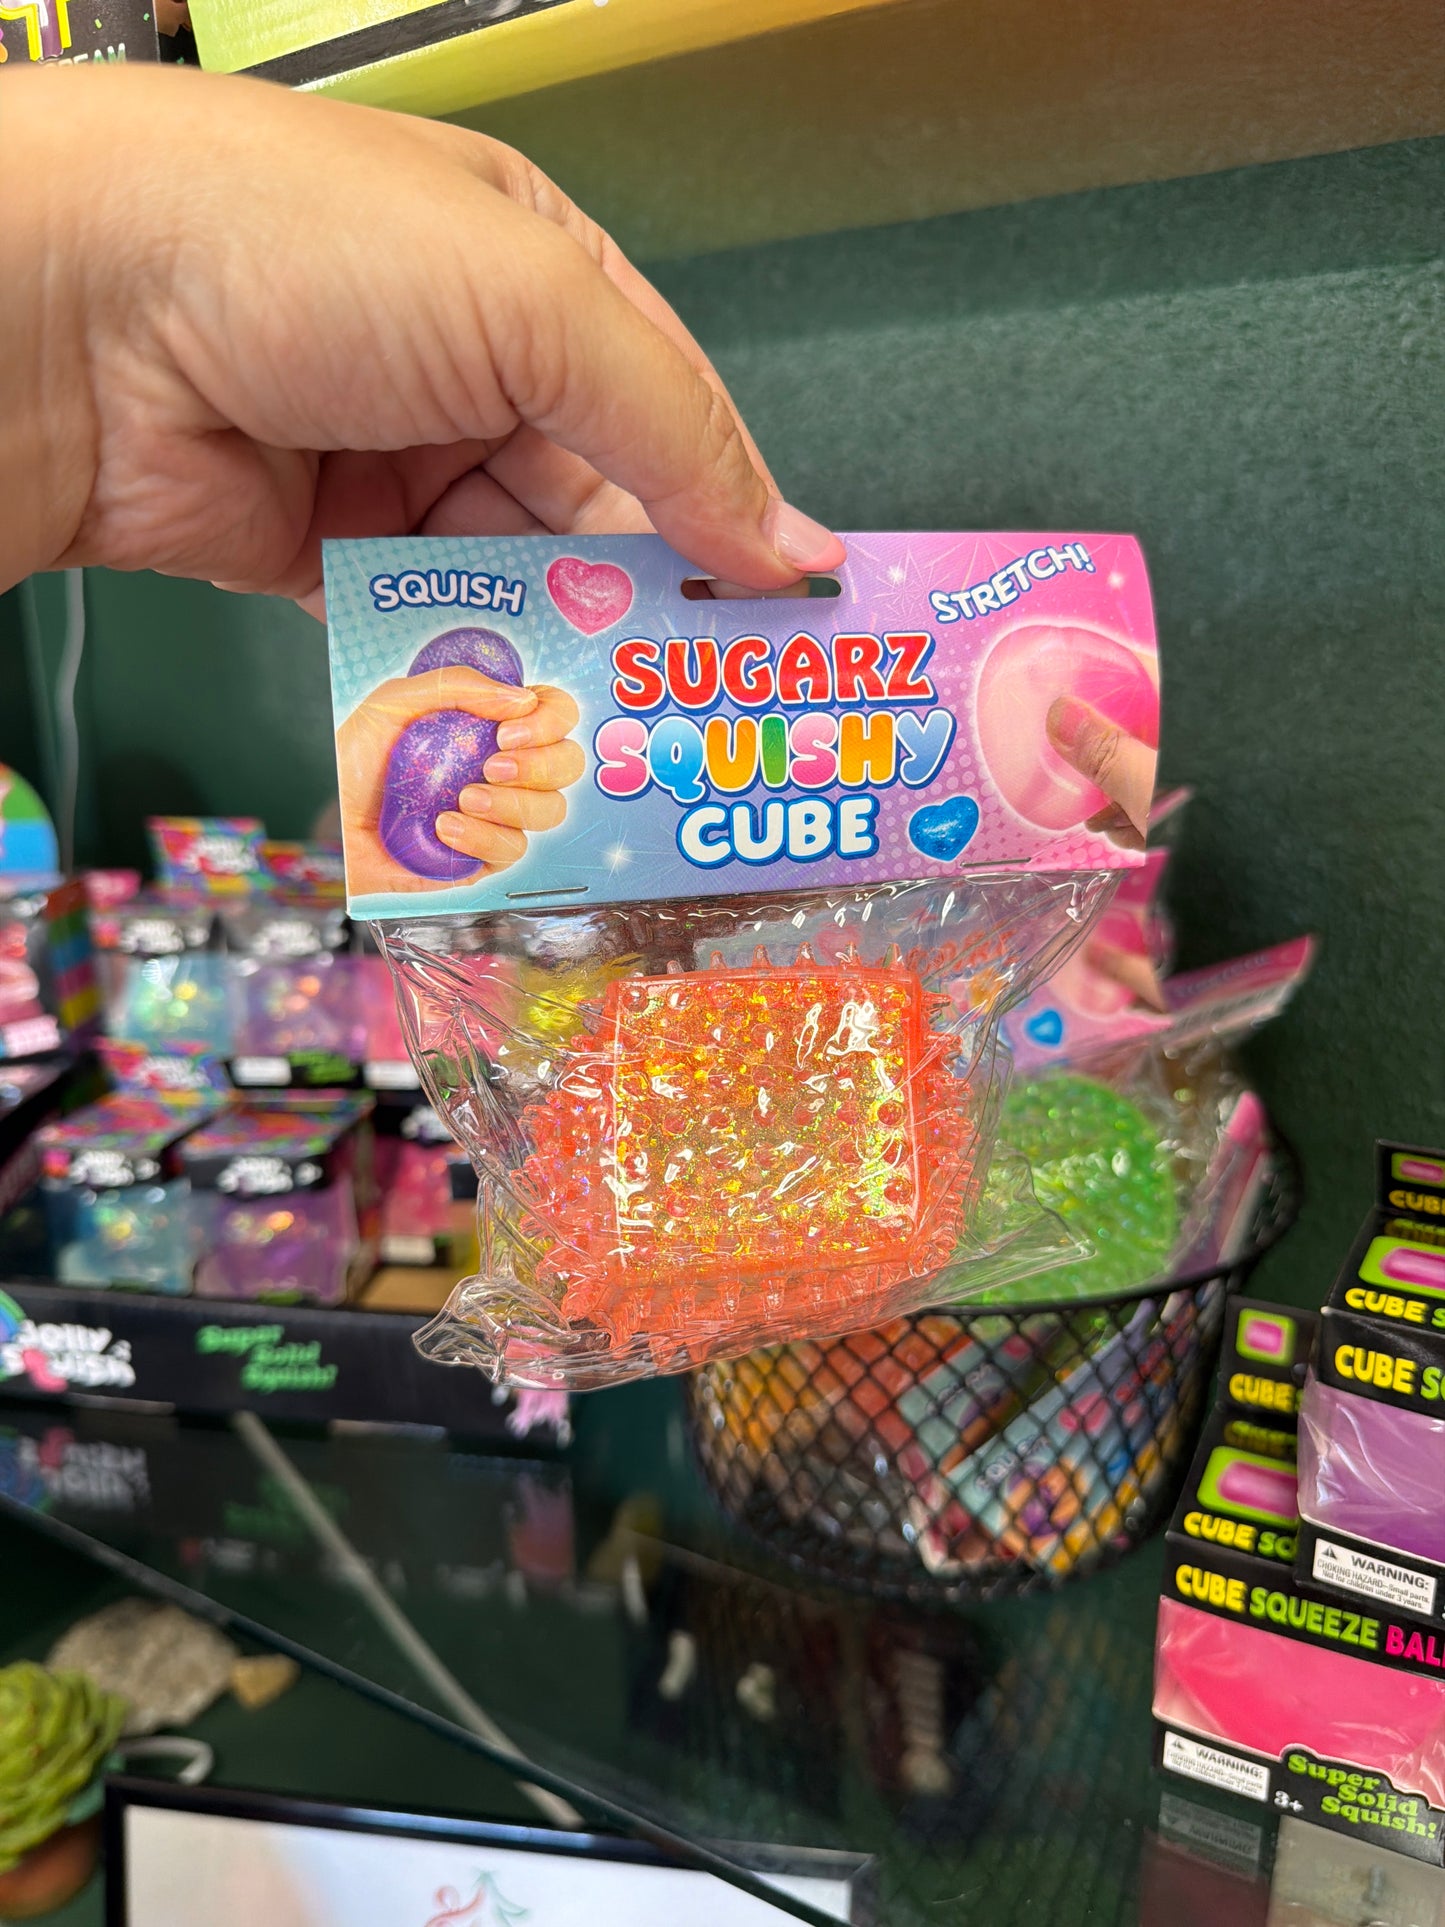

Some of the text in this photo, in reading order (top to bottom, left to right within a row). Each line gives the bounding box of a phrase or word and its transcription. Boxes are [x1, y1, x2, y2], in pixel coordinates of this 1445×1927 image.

[370, 569, 526, 616] SQUISH
[929, 543, 1096, 624] STRETCH!
[611, 632, 937, 713] SUGARZ
[594, 709, 955, 806] SQUISHY
[676, 795, 879, 869] CUBE
[1345, 1288, 1429, 1323] CUBE
[1335, 1345, 1417, 1395] CUBE
[1229, 1373, 1294, 1413] CUBE
[1184, 1511, 1257, 1550] CUBE
[1317, 1559, 1351, 1578] CHOKING
[1351, 1555, 1429, 1590] WARNING:
[1176, 1564, 1246, 1613] CUBE
[1250, 1587, 1380, 1649] SQUEEZE
[1346, 1578, 1374, 1593] children
[1375, 1586, 1395, 1600] under
[1196, 1747, 1263, 1779] WARNING:
[1288, 1754, 1380, 1791] Super
[1274, 1790, 1304, 1812] 3+
[1321, 1795, 1437, 1839] Squish!
[1338, 1783, 1418, 1816] Solid
